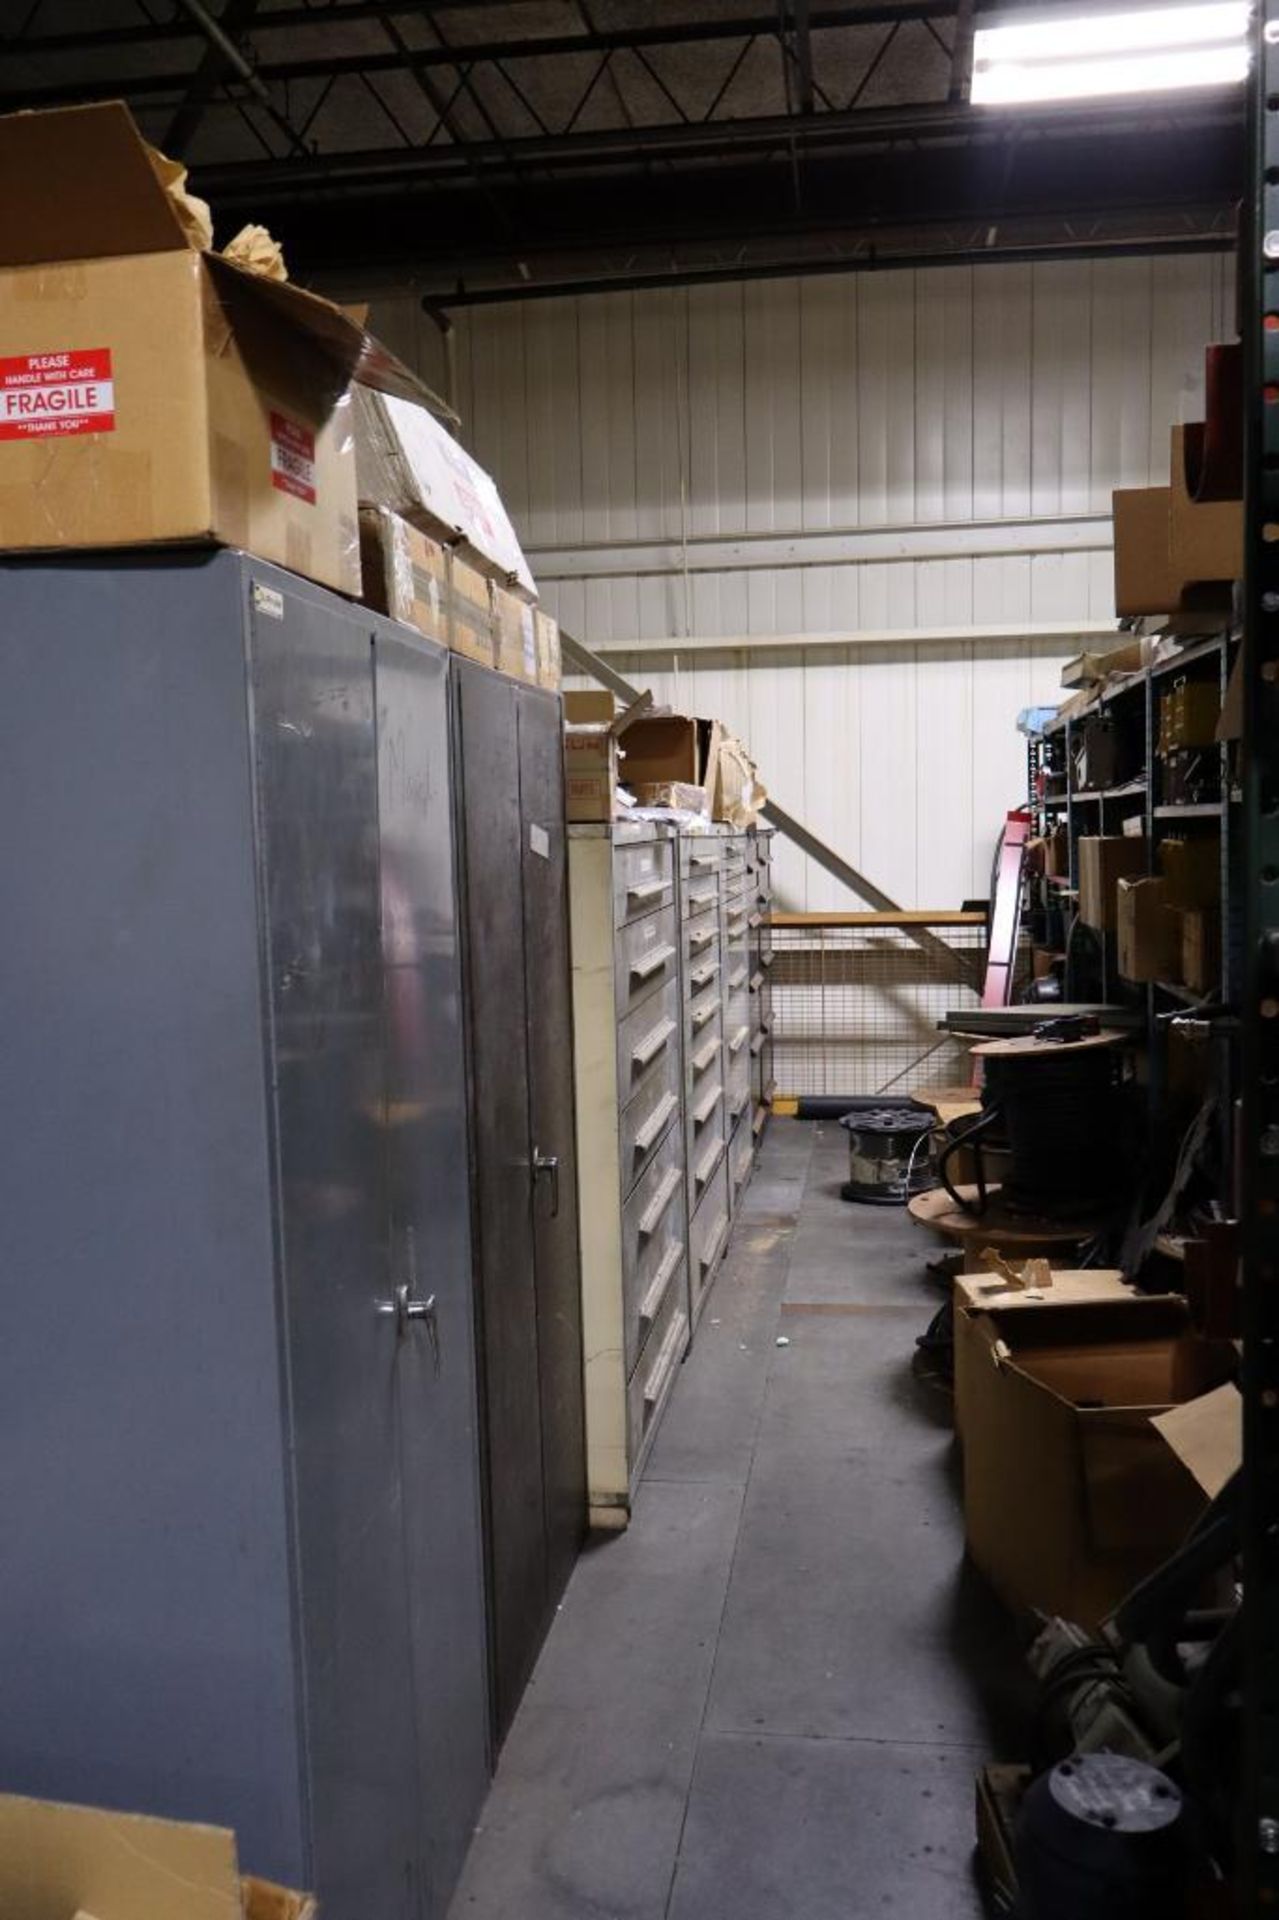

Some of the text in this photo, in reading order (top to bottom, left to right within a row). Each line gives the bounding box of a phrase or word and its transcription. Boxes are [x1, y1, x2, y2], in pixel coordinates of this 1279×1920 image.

[28, 355, 70, 370] PLEASE
[5, 367, 95, 385] HANDLE WITH CARE
[6, 387, 97, 415] FRAGILE
